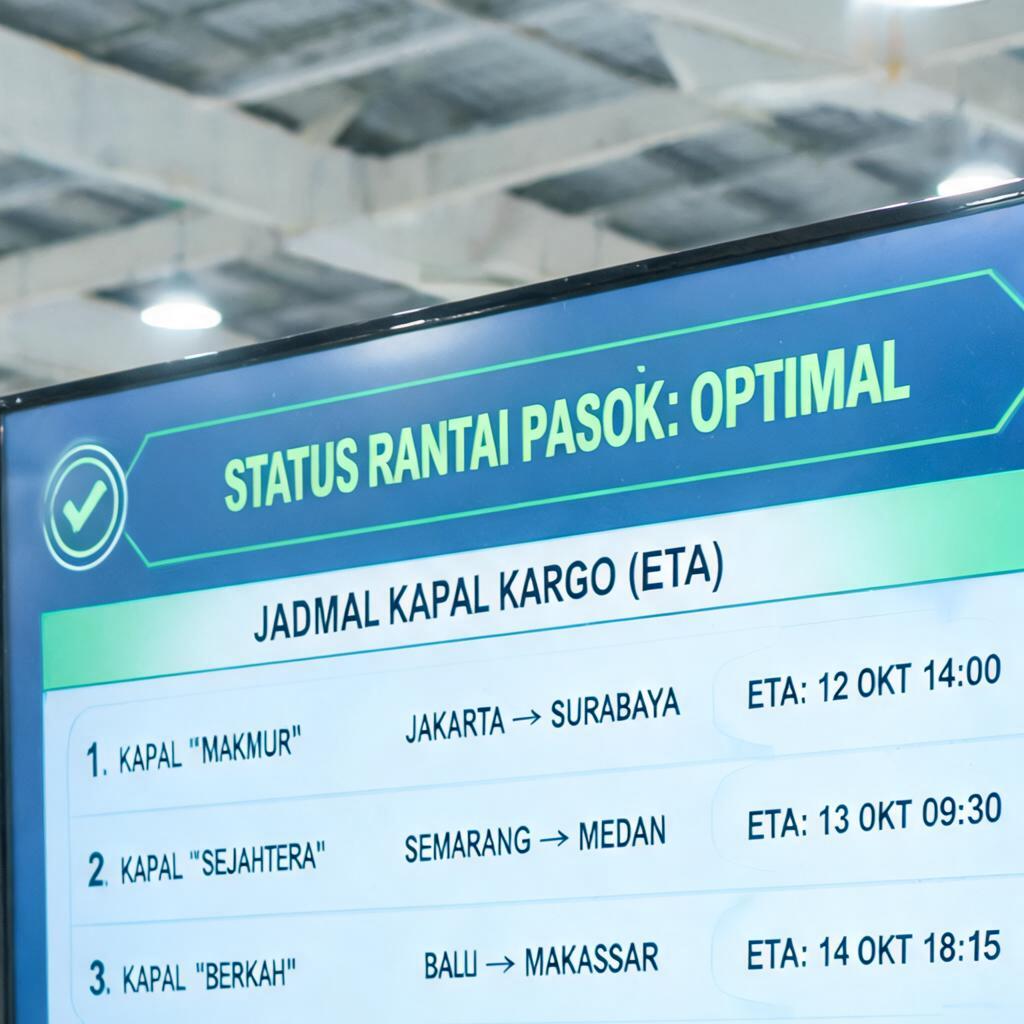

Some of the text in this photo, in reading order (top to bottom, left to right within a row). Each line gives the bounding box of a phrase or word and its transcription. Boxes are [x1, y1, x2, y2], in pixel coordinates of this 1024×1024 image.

[224, 339, 911, 512] STATUS RANTAI PASOK: OPTIMAL
[254, 541, 724, 642] JADMAL KAPAL KARGO (ETA)
[748, 653, 1002, 709] ETA: 12 OKT 14:00
[405, 686, 681, 743] JAKARTA SURABAYA
[86, 724, 301, 777] 1. KAPAL "MAKMUR"
[405, 814, 666, 863] SEMARANG MEDAN
[748, 792, 1002, 840] ETA: 13 OKT 09:30
[88, 840, 325, 887] 2. KAPAL "SEJAHTERA"
[525, 942, 659, 977] MAKASSAR
[747, 929, 1001, 970] ETA: 14 OKT 18:15
[89, 958, 296, 996] 3. KAPAL "BERKAH"
